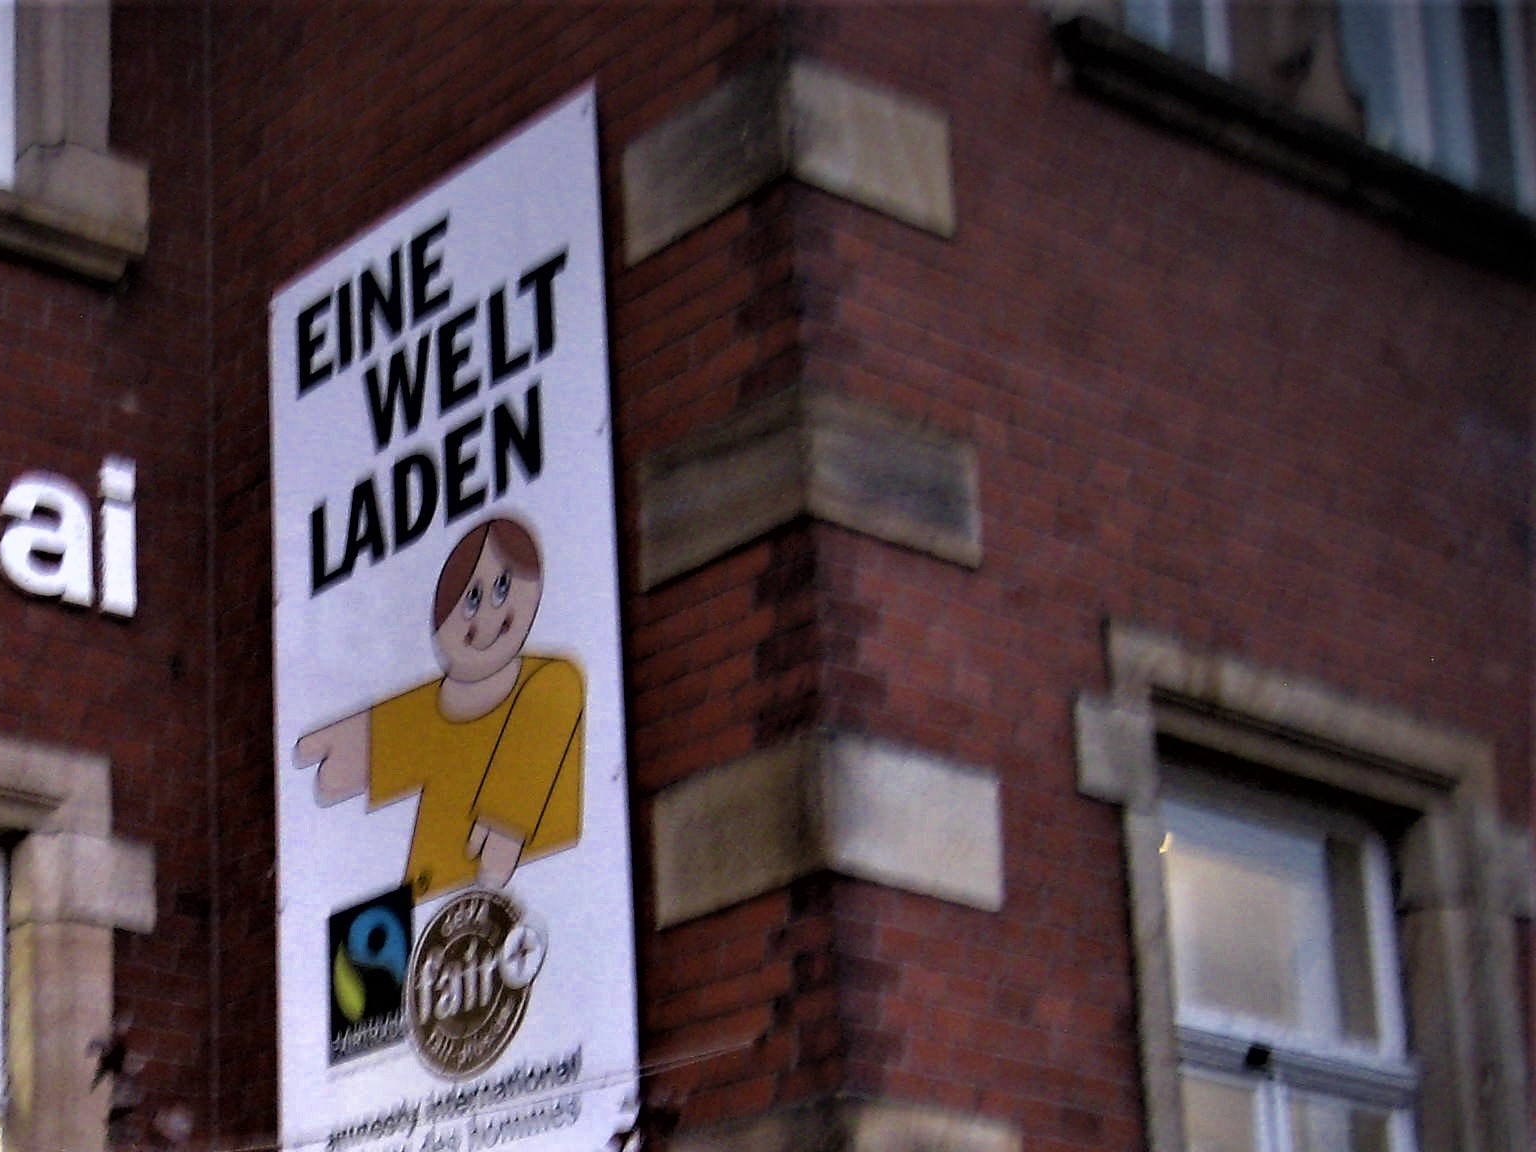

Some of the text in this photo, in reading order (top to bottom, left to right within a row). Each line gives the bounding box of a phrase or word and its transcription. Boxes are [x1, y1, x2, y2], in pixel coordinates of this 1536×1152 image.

[297, 213, 450, 398] EINE
[363, 244, 568, 454] WELT
[310, 377, 543, 597] LADEN
